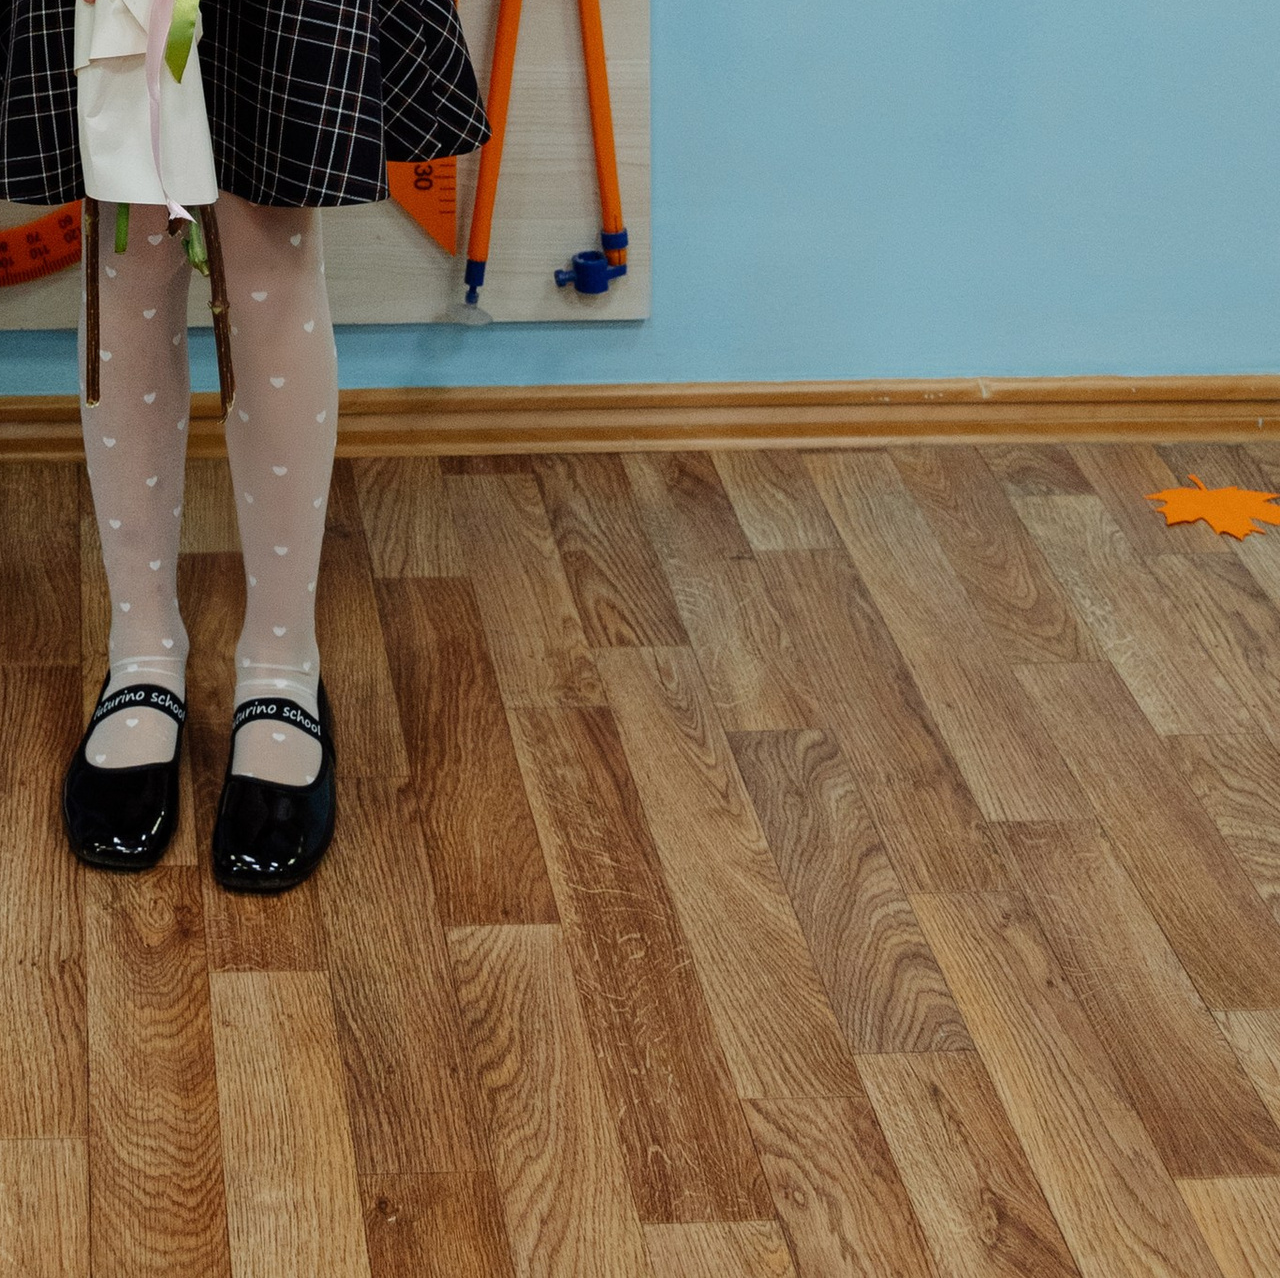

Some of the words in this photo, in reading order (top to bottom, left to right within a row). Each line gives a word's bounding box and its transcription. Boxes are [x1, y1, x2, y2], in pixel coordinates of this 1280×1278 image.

[414, 165, 433, 190] 30
[150, 692, 186, 722] school
[282, 706, 322, 736] school
